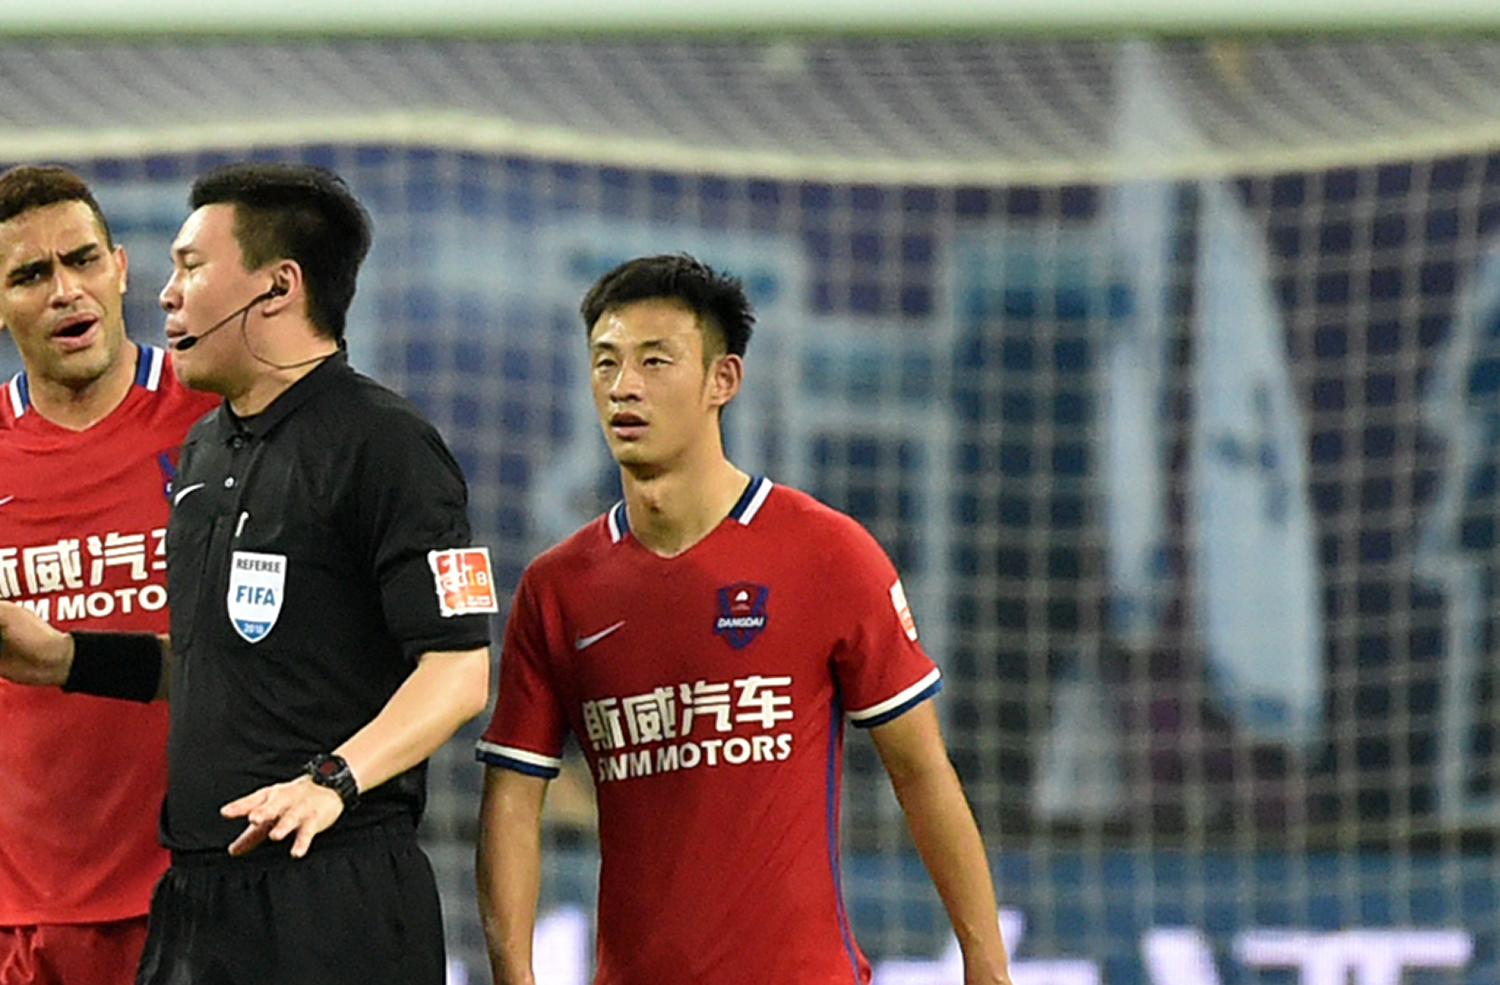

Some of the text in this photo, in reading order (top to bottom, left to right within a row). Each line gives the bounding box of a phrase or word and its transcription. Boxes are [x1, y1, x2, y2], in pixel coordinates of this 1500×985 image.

[236, 558, 281, 573] REFEREE
[57, 584, 168, 621] MOTO
[236, 585, 276, 607] FIFA
[717, 616, 764, 629] DANGDAI
[582, 675, 794, 751] 斯威汽车
[656, 733, 793, 773] MOTORS
